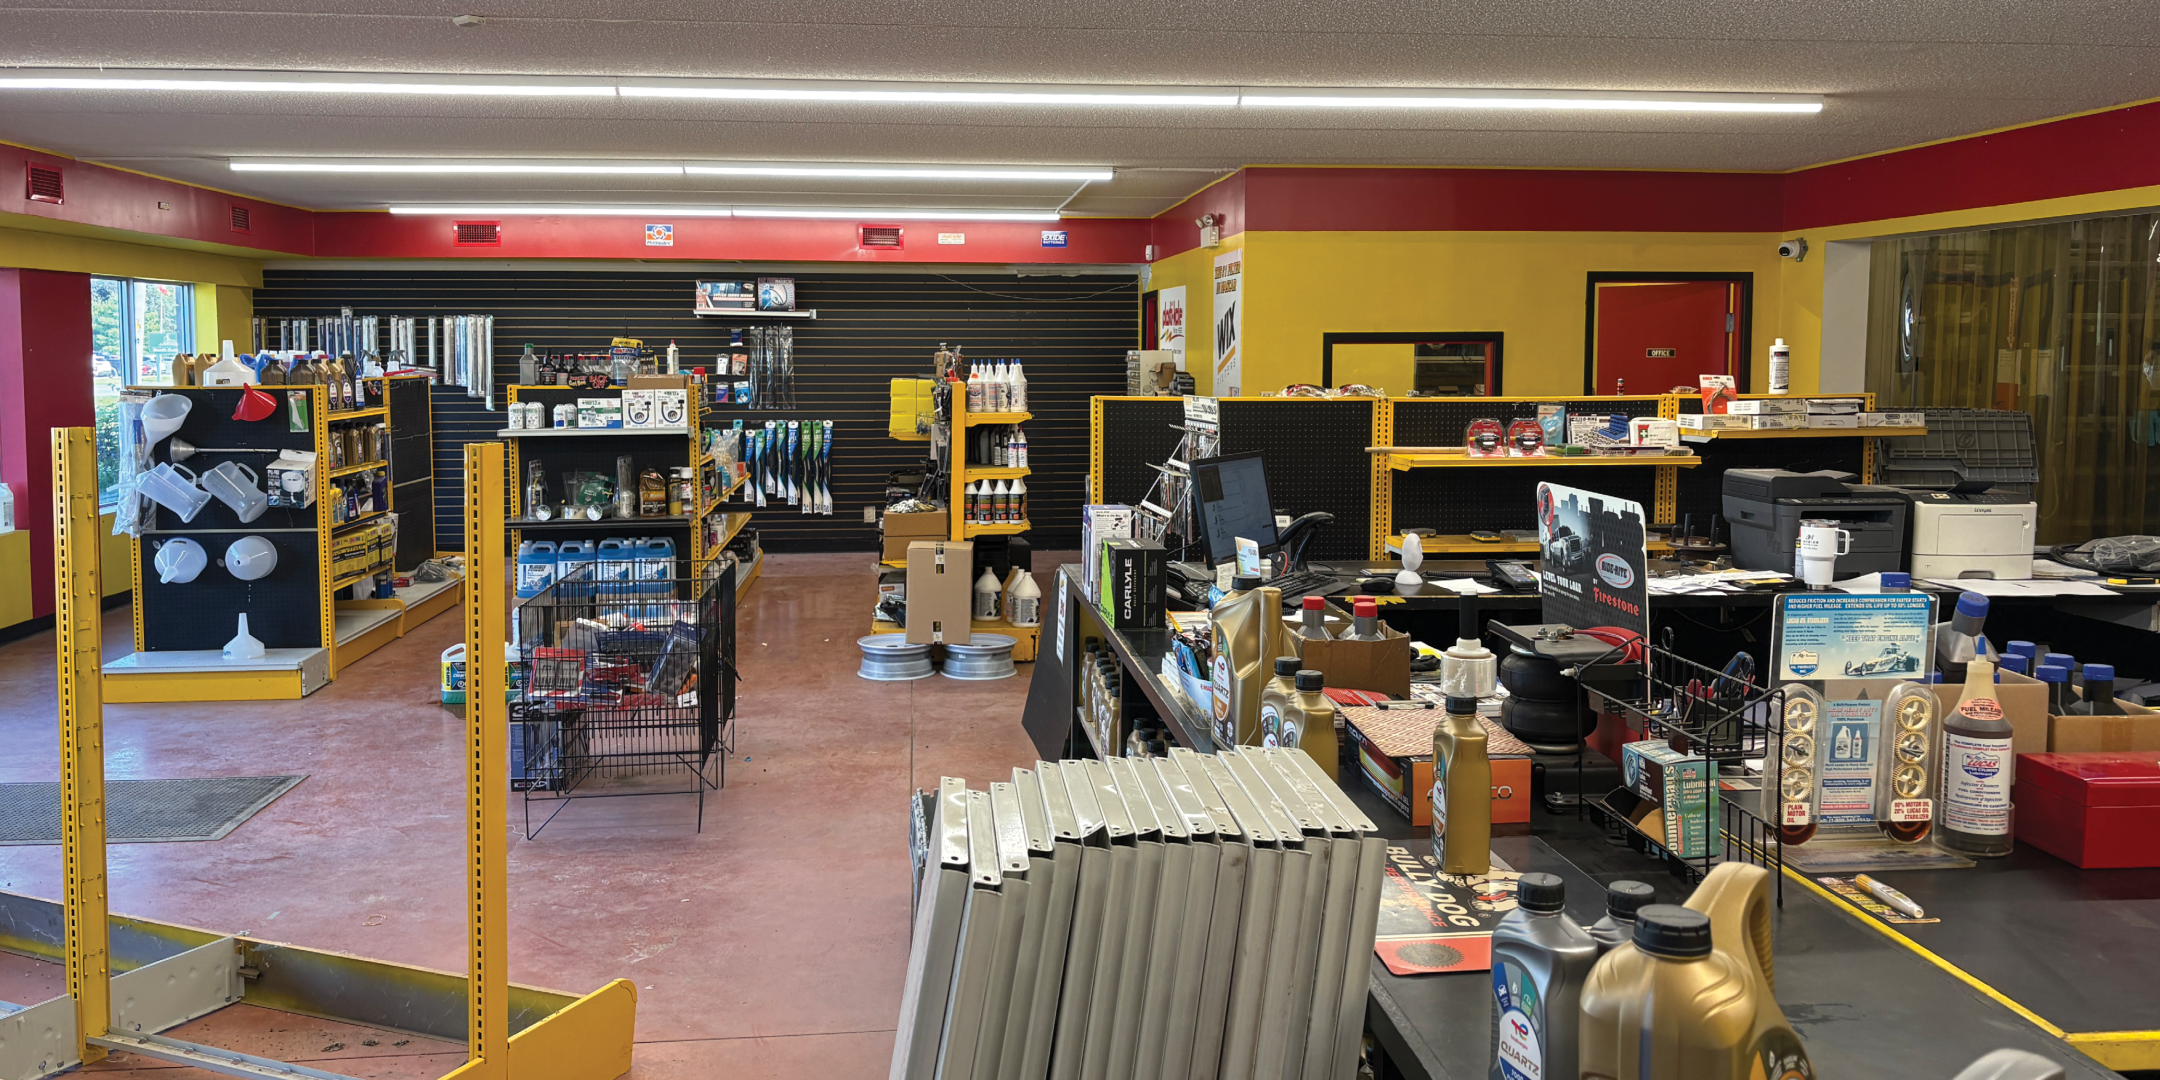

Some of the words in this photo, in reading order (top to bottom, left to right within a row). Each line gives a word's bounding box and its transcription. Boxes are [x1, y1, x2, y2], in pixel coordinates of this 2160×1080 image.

[1217, 300, 1236, 360] WIX
[1543, 570, 1556, 582] LEVEL
[1557, 575, 1568, 588] YOUR
[1601, 560, 1628, 578] RIDE-RITE
[1124, 558, 1132, 620] CARLYLE
[1593, 587, 1639, 616] Firestone
[1213, 680, 1229, 698] QUARTZ
[1683, 779, 1716, 789] Lubrifint
[1387, 846, 1445, 890] BULLY
[1384, 866, 1448, 928] PERFORMANCE
[1425, 892, 1480, 927] DOG
[1500, 1040, 1540, 1076] QUARTZ
